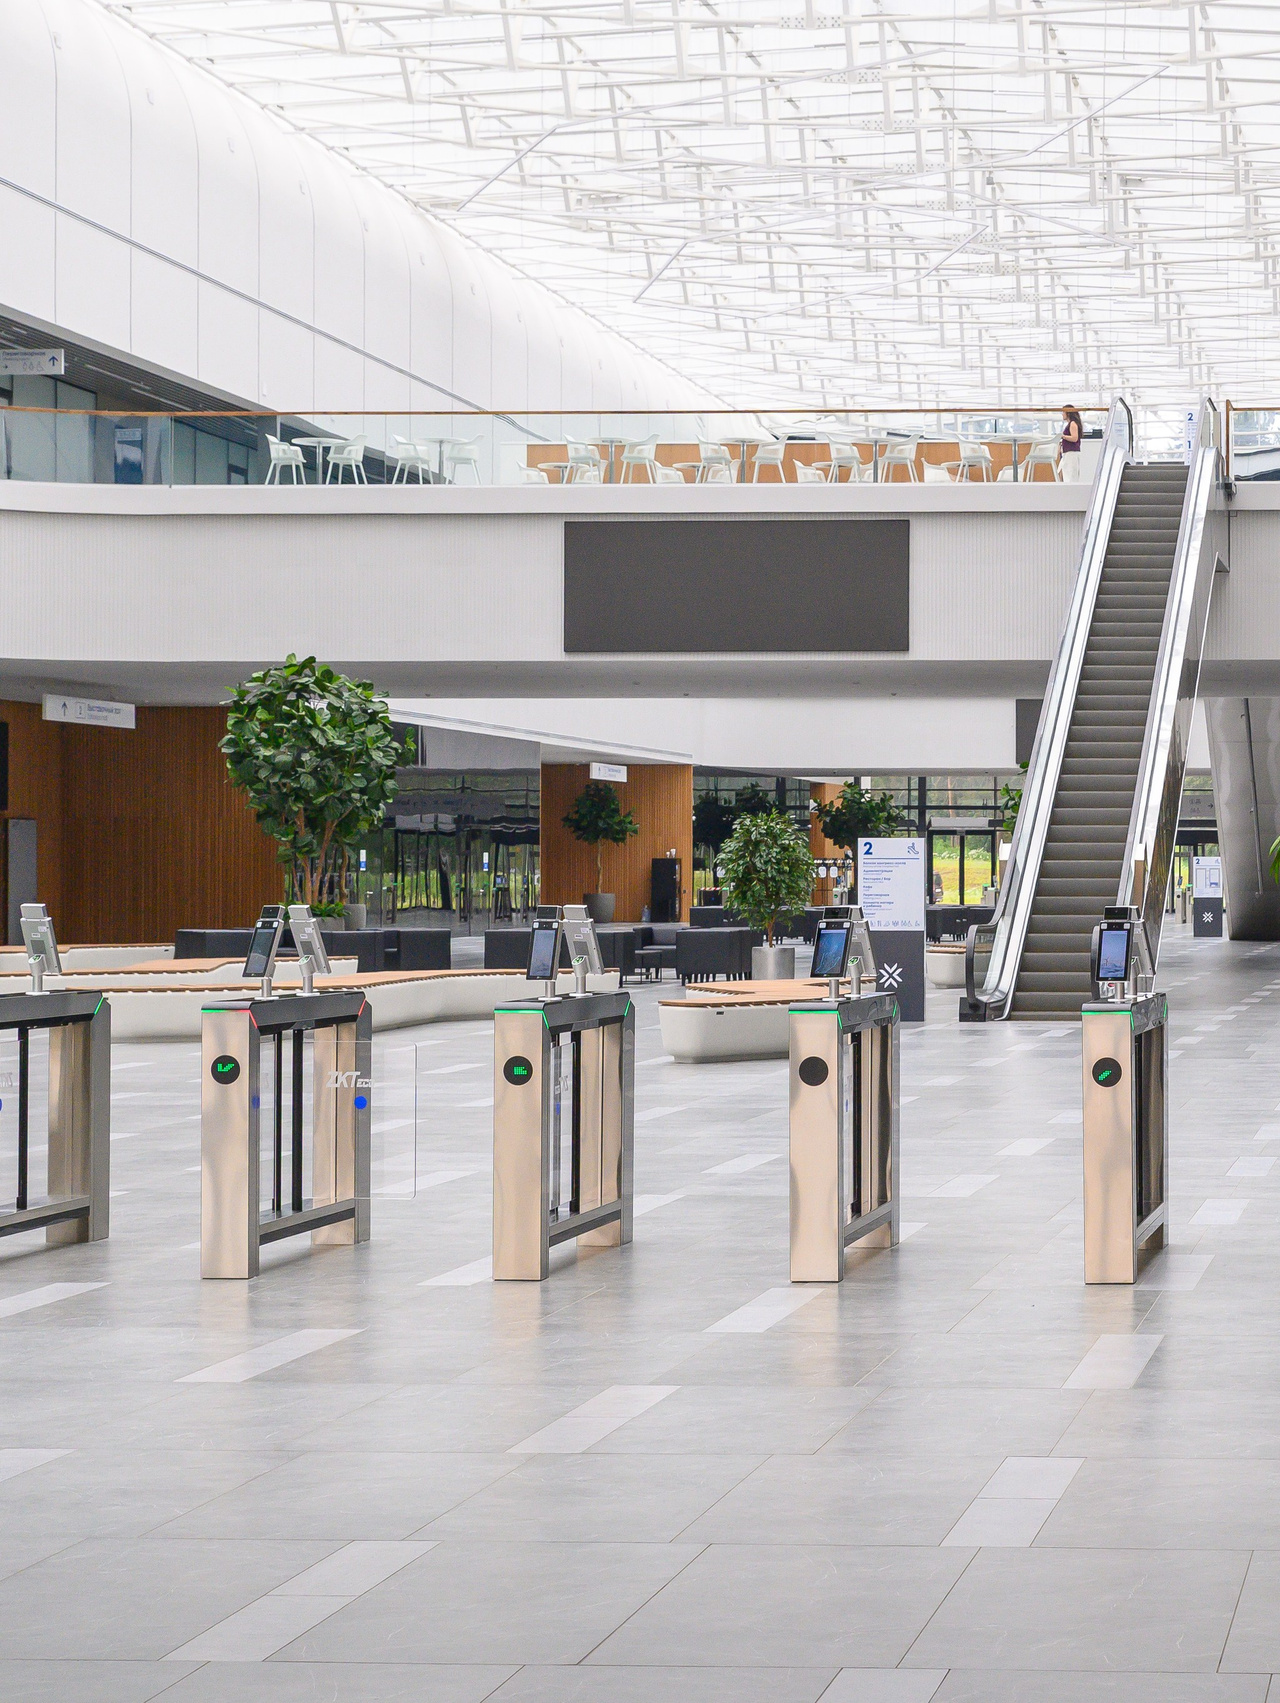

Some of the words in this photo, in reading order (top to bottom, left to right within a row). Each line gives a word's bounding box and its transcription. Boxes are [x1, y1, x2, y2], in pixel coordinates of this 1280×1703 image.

[1188, 412, 1194, 421] 2
[1188, 440, 1191, 449] 1
[864, 842, 872, 855] 2
